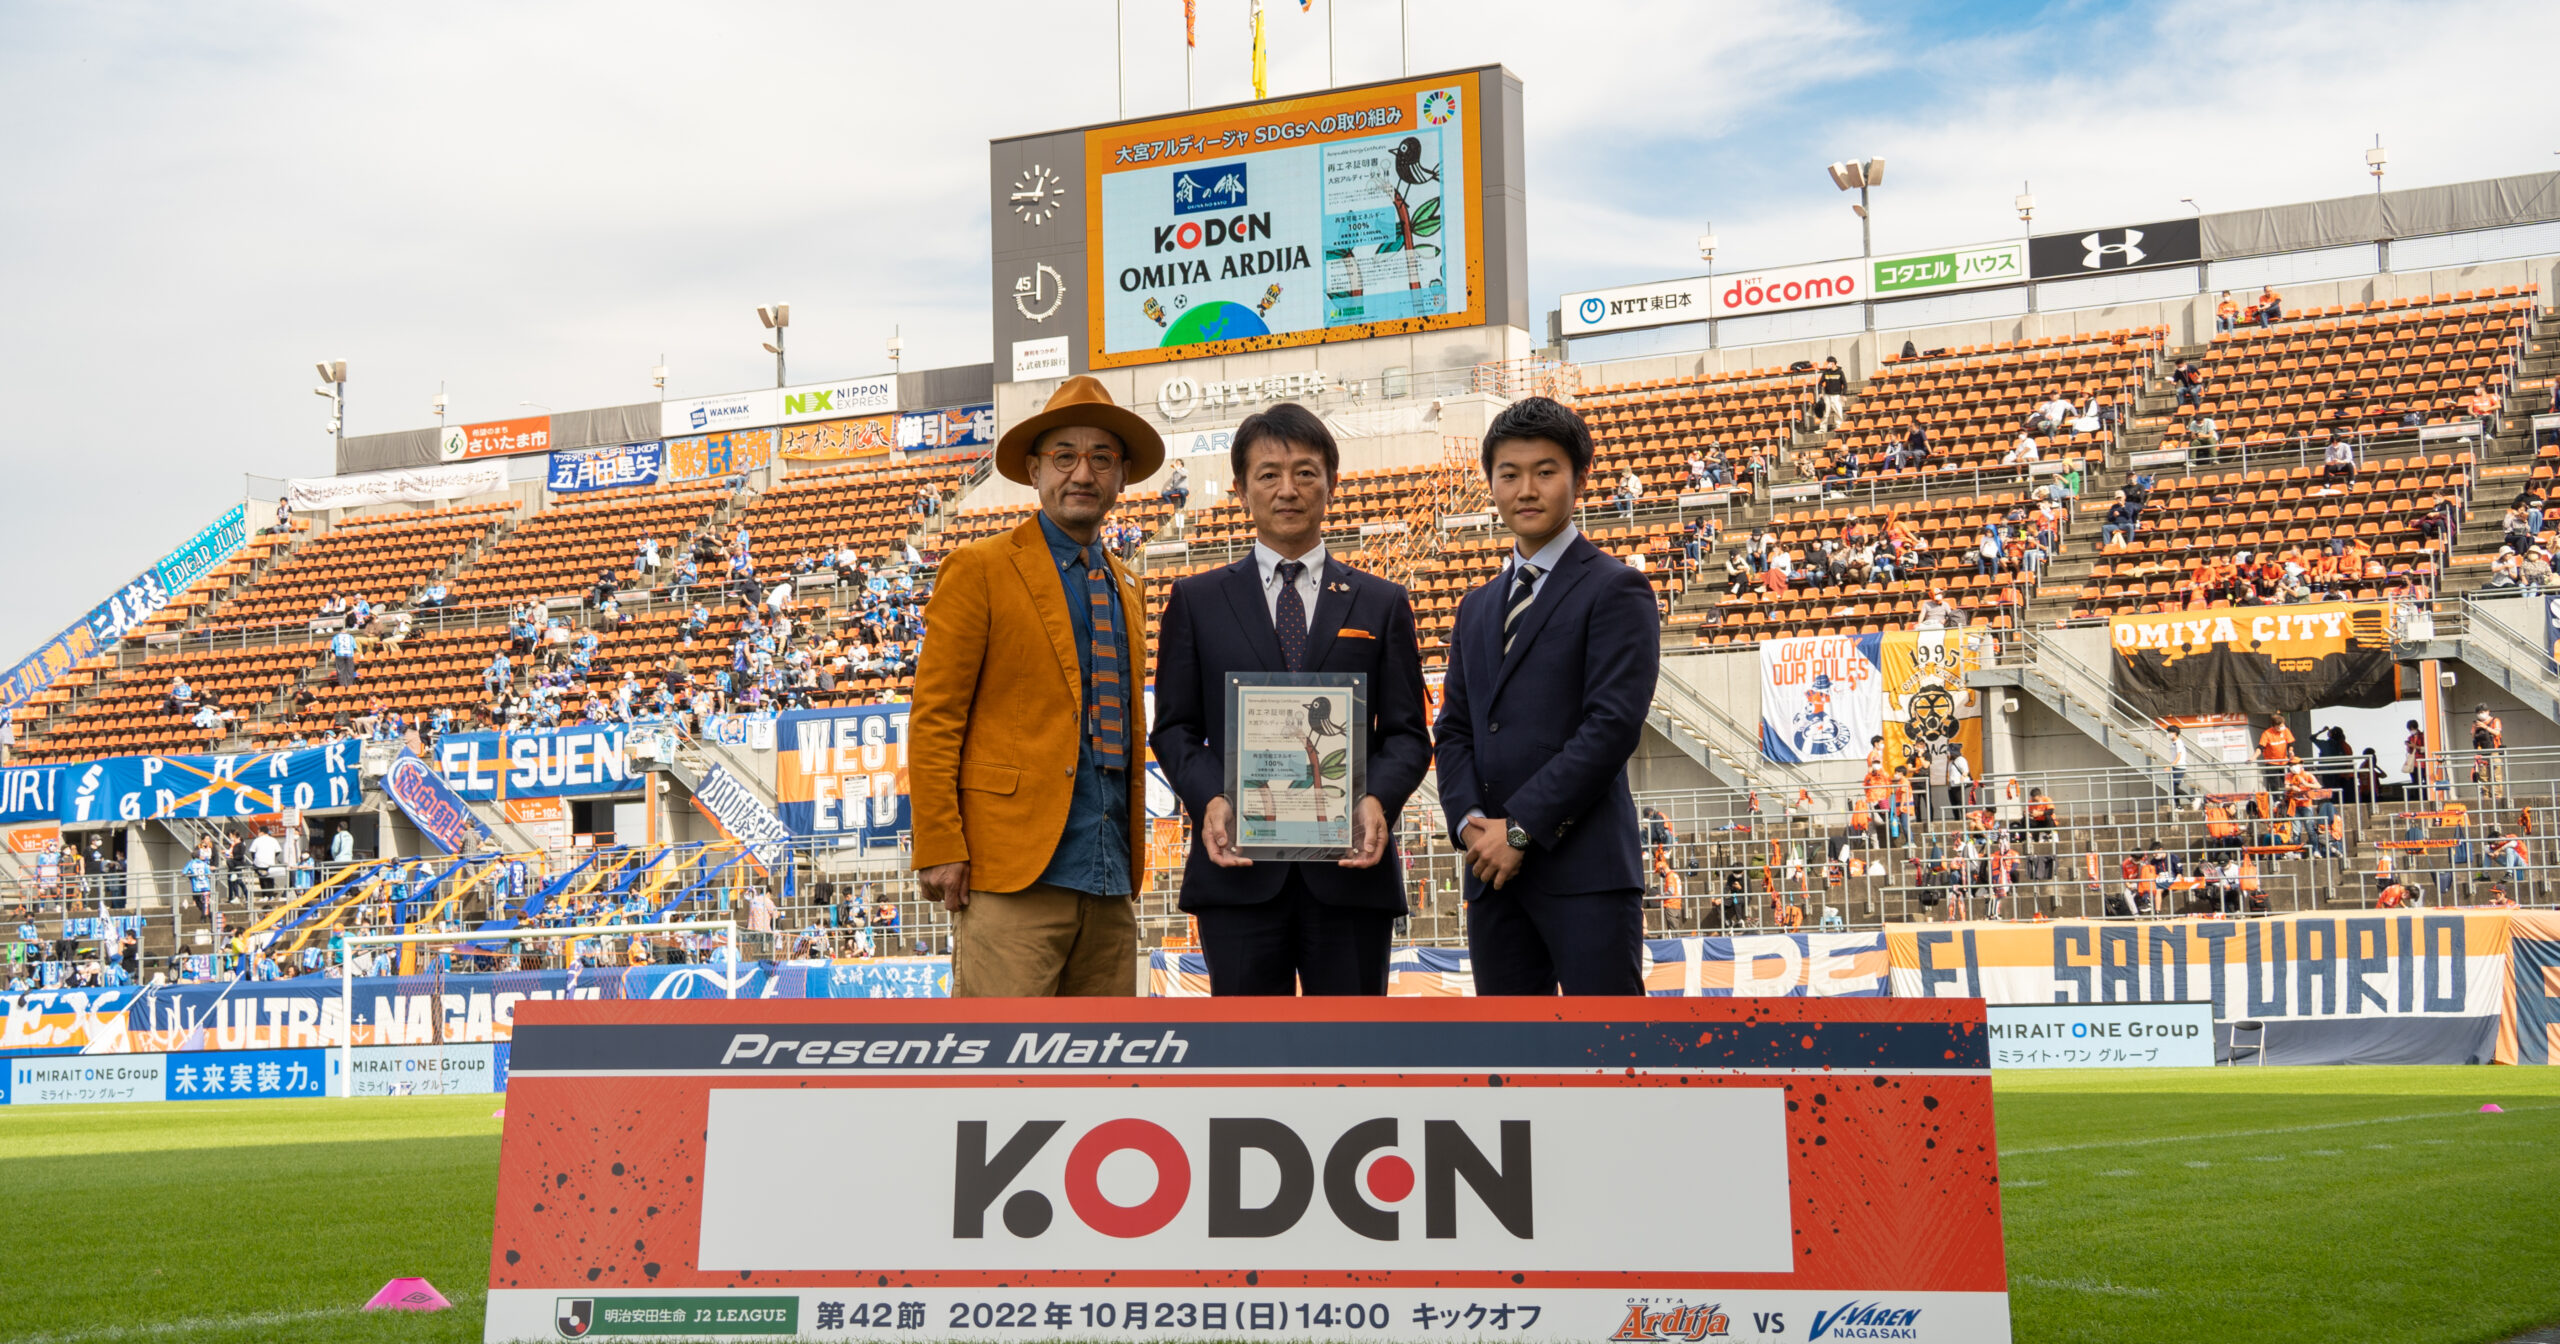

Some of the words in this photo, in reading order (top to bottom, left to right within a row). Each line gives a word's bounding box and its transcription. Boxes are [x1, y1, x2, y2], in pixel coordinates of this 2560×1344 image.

[1115, 132, 1249, 165] 大宮アルディージャ
[1255, 106, 1402, 144] SDGsへの取り組み
[1154, 212, 1271, 254] KODEN
[1348, 222, 1369, 231] 100%
[1119, 259, 1212, 293] OMIYA
[1220, 245, 1311, 280] ARDIJA
[1744, 277, 1762, 285] NTT
[1881, 261, 1951, 285] コタエル
[1963, 254, 2015, 275] ハウス
[1015, 276, 1031, 291] 45
[1723, 275, 1854, 309] docomo
[1026, 358, 1066, 370] 武蔵野銀行
[785, 390, 834, 415] NX
[837, 384, 888, 399] NIPPON
[837, 395, 889, 410] EXPRESS
[709, 405, 749, 417] WAKWAK
[469, 431, 547, 453] さいたま市
[550, 456, 659, 489] 五月田星矢
[165, 545, 212, 588] EDIGAR
[2114, 617, 2238, 648] OMIYA
[2251, 611, 2345, 642] CITY
[1781, 640, 1816, 662] OUR
[1821, 637, 1863, 659] CITY
[1909, 645, 1960, 668] 1995
[1773, 663, 1806, 686] OUR
[1812, 657, 1869, 682] RULES
[797, 713, 910, 775] WEST
[443, 741, 494, 791] EL
[813, 771, 898, 831] END
[832, 964, 936, 986] 長崎への土産
[2052, 914, 2467, 1019] SANTUARIO
[216, 996, 343, 1050] ULTRA
[1989, 1023, 2065, 1040] MIRAIT
[2072, 1022, 2122, 1040] ONE
[2128, 1021, 2199, 1042] Group
[720, 1031, 991, 1066] Presents
[1006, 1030, 1191, 1065] Match
[2099, 1047, 2159, 1062] グループ
[36, 1069, 82, 1083] MIRAIT
[85, 1068, 113, 1082] ONE
[118, 1067, 158, 1081] Group
[175, 1061, 319, 1095] 未来実装力。
[353, 1060, 402, 1073] MIRAIT
[406, 1059, 437, 1071] ONE
[441, 1058, 485, 1071] Group
[99, 1087, 134, 1099] グループ
[422, 1079, 459, 1091] グループ
[953, 1117, 1534, 1241] KODEN
[604, 1308, 686, 1323] 明治安田生命
[694, 1308, 712, 1323] J2
[716, 1308, 787, 1323] LEAGUE
[816, 1301, 925, 1330] 第42節
[1412, 1303, 1541, 1331] キックオフ
[1612, 1303, 1730, 1342] Ardija
[1753, 1312, 1784, 1333] VS
[1834, 1328, 1916, 1339] NAGASAKI
